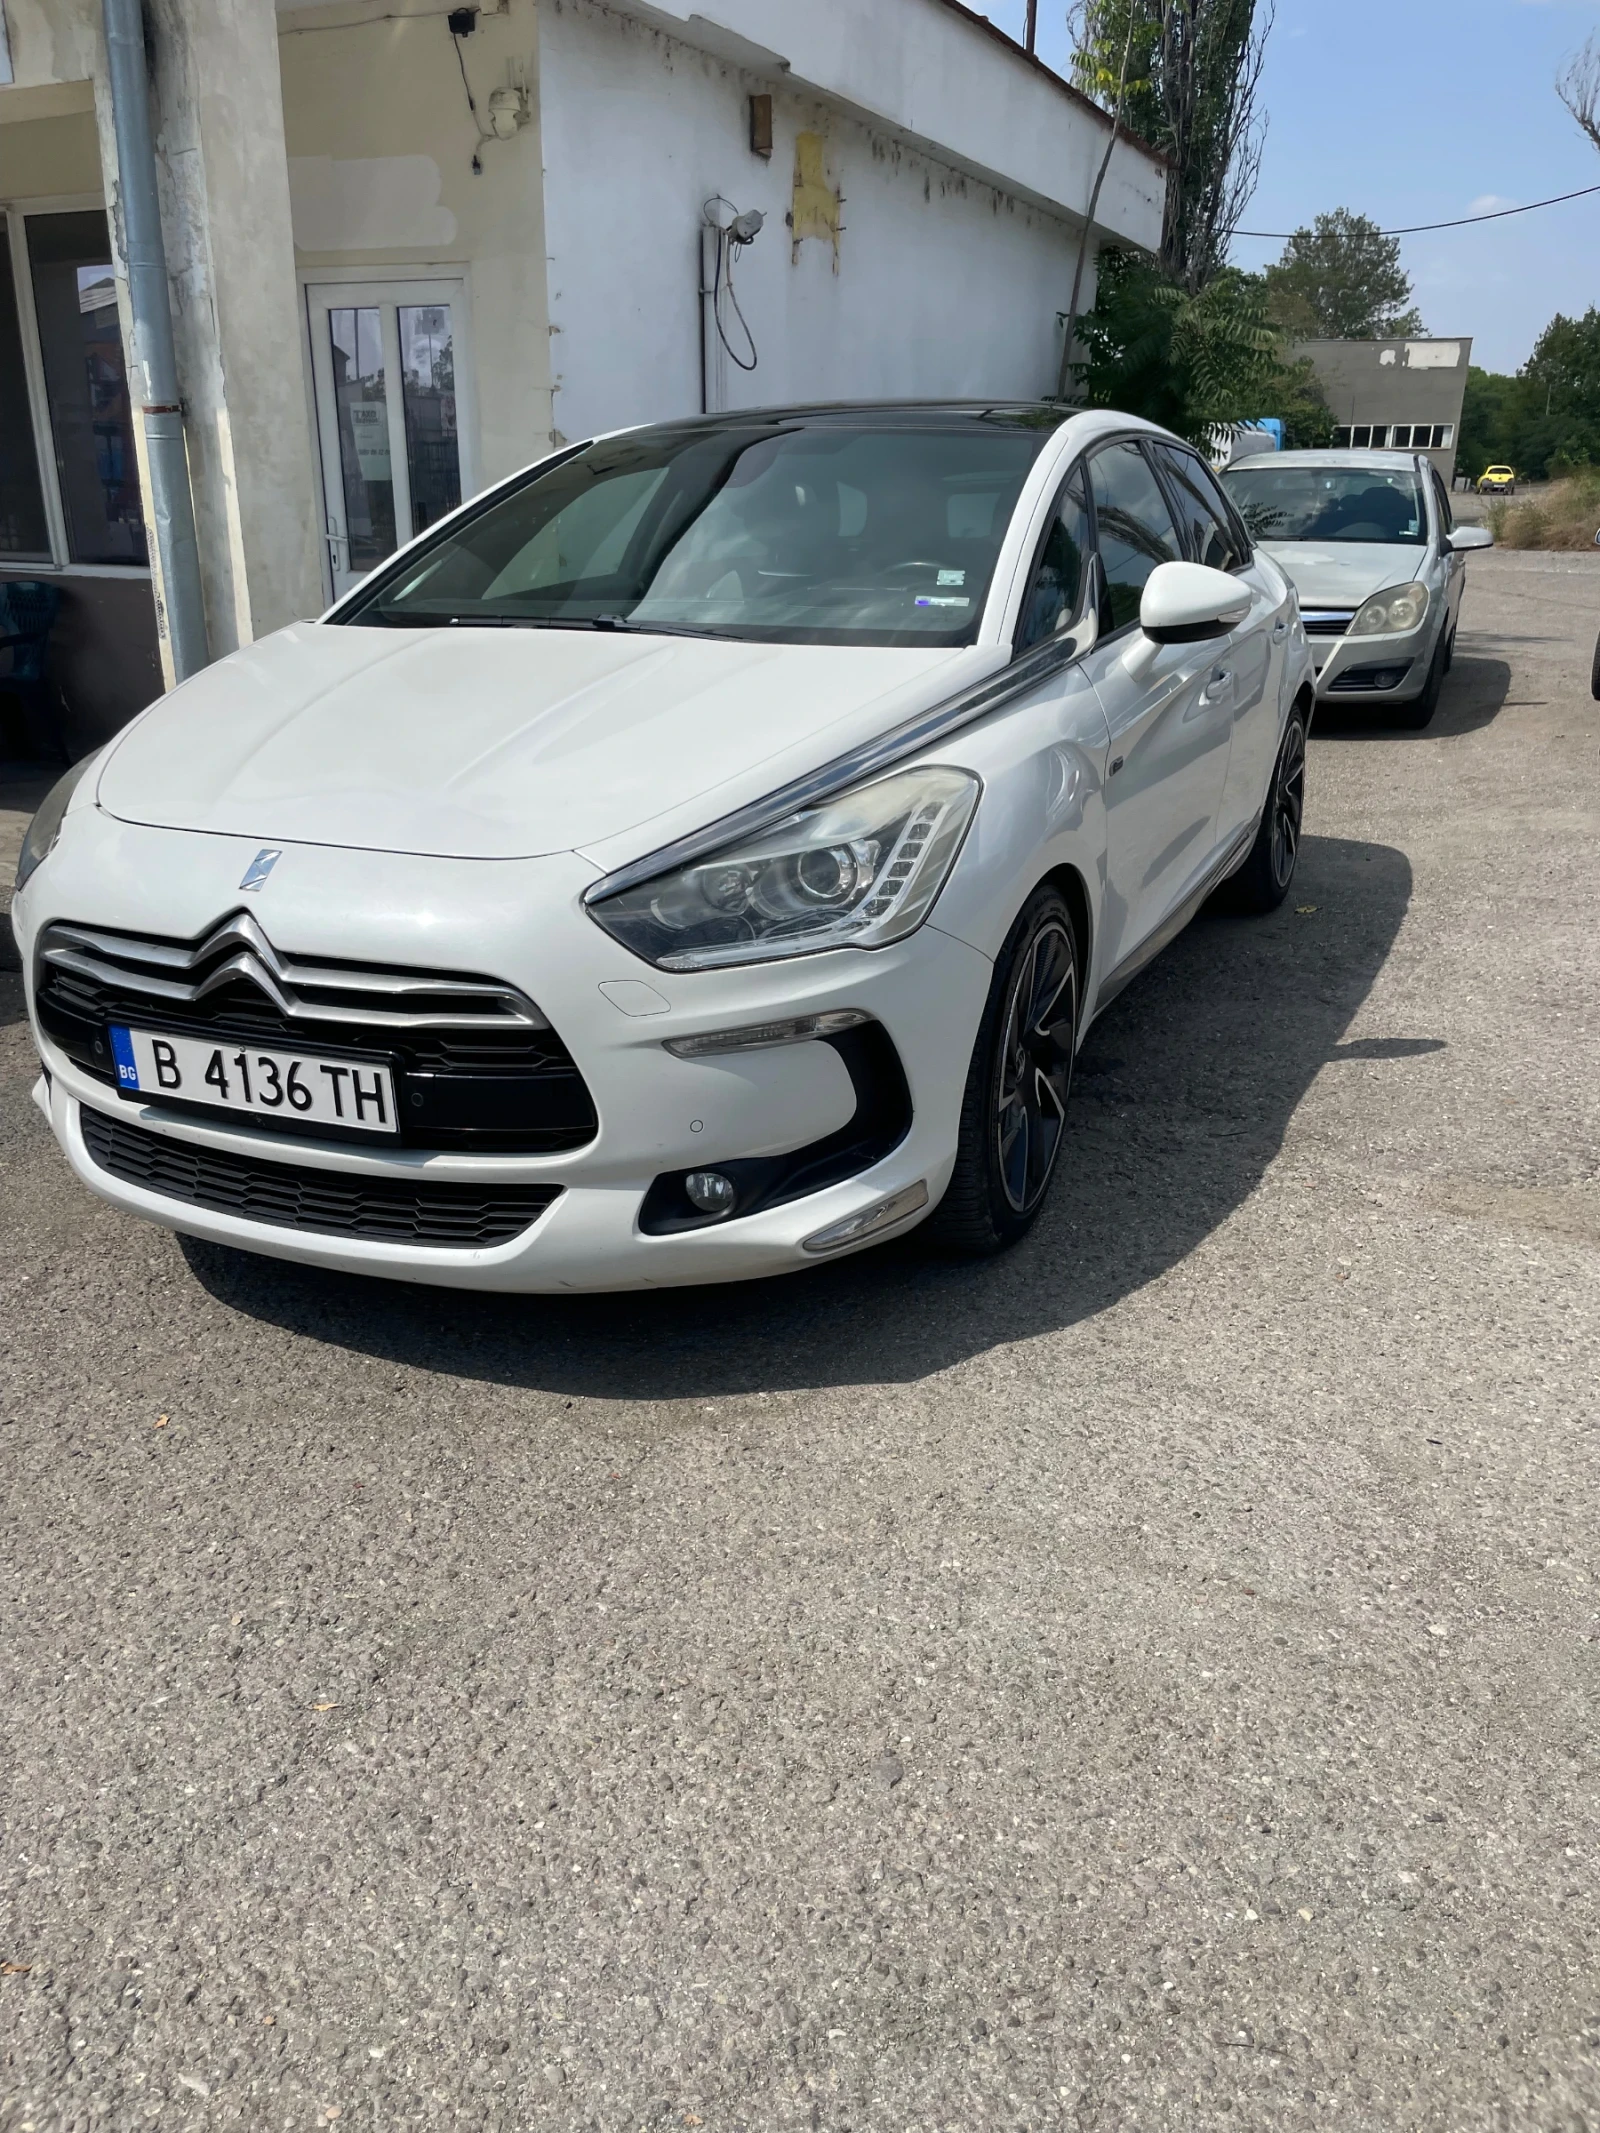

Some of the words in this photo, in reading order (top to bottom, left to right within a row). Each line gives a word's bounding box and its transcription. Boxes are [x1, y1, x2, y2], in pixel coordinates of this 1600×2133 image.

[119, 1065, 137, 1081] BG
[151, 1039, 182, 1089] B
[204, 1049, 312, 1111] 4136
[319, 1065, 387, 1124] TH
